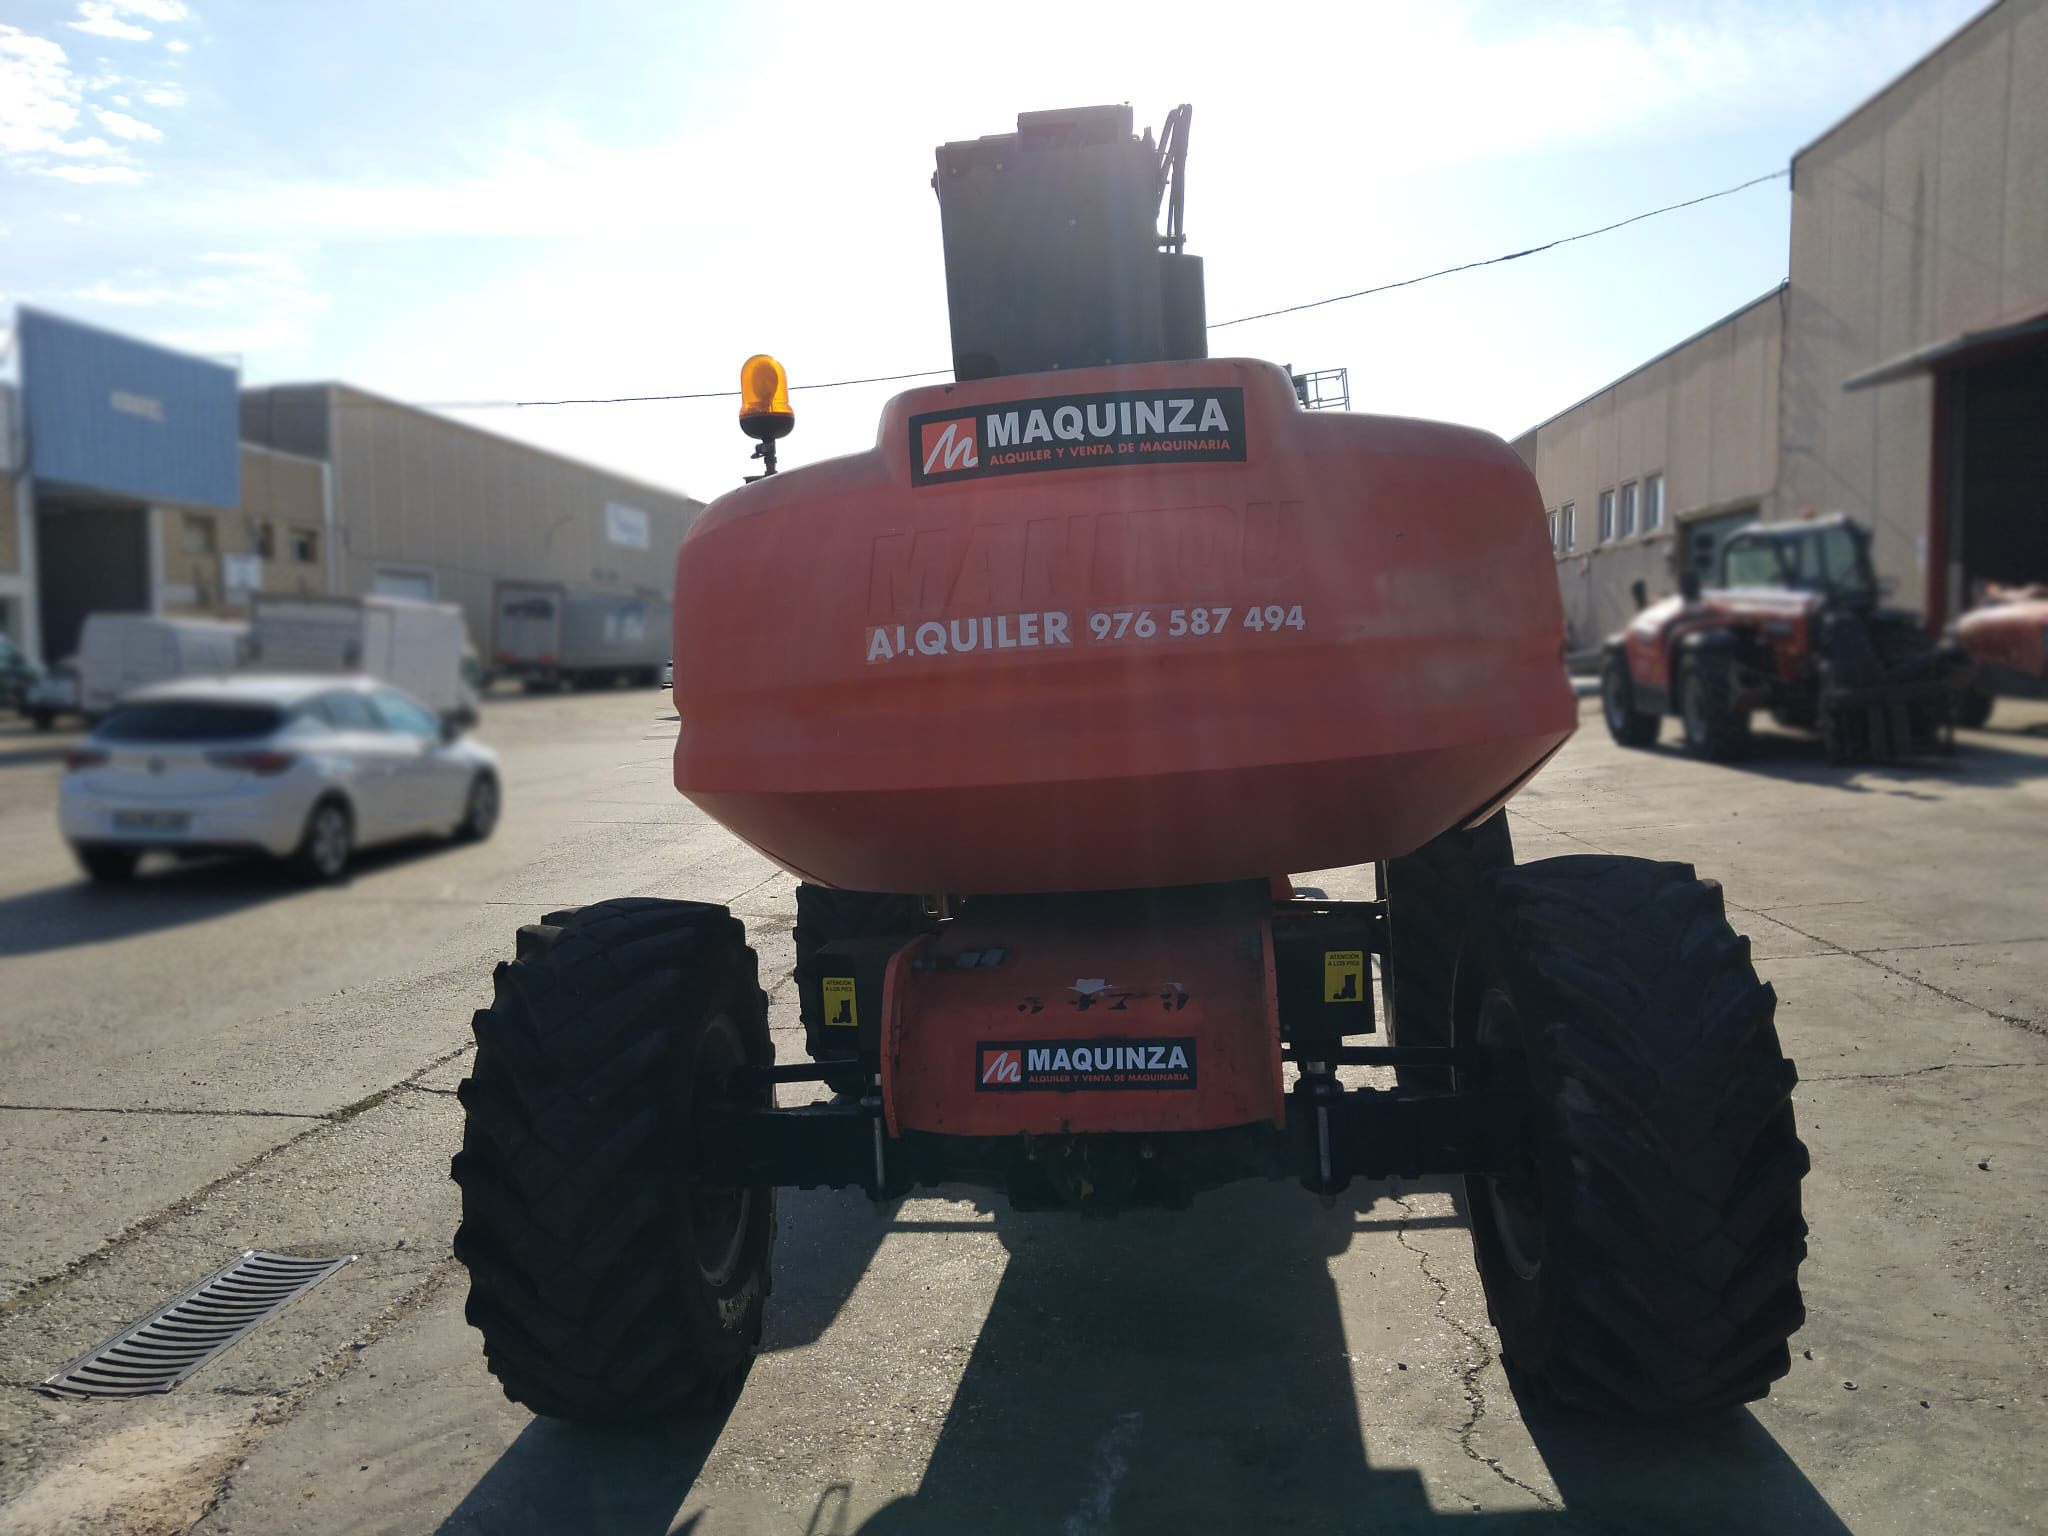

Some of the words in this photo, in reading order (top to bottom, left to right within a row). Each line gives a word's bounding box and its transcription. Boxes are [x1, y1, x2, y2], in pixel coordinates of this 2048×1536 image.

[986, 398, 1230, 448] MAQUINZA
[990, 448, 1052, 466] ALQUILER
[1056, 447, 1065, 458] Y
[1069, 444, 1114, 457] VENTA
[1118, 443, 1135, 454] DE
[1140, 439, 1231, 453] MAQUINARIA
[1089, 611, 1157, 641] 976
[1169, 608, 1232, 638] 587
[1243, 605, 1306, 632] 494
[1028, 1046, 1189, 1072] MAQUINZA
[1029, 1075, 1071, 1083] ALQUILER
[1082, 1074, 1111, 1082] VENTA
[1114, 1074, 1125, 1082] DE
[1128, 1073, 1189, 1082] MAQUINARIA
